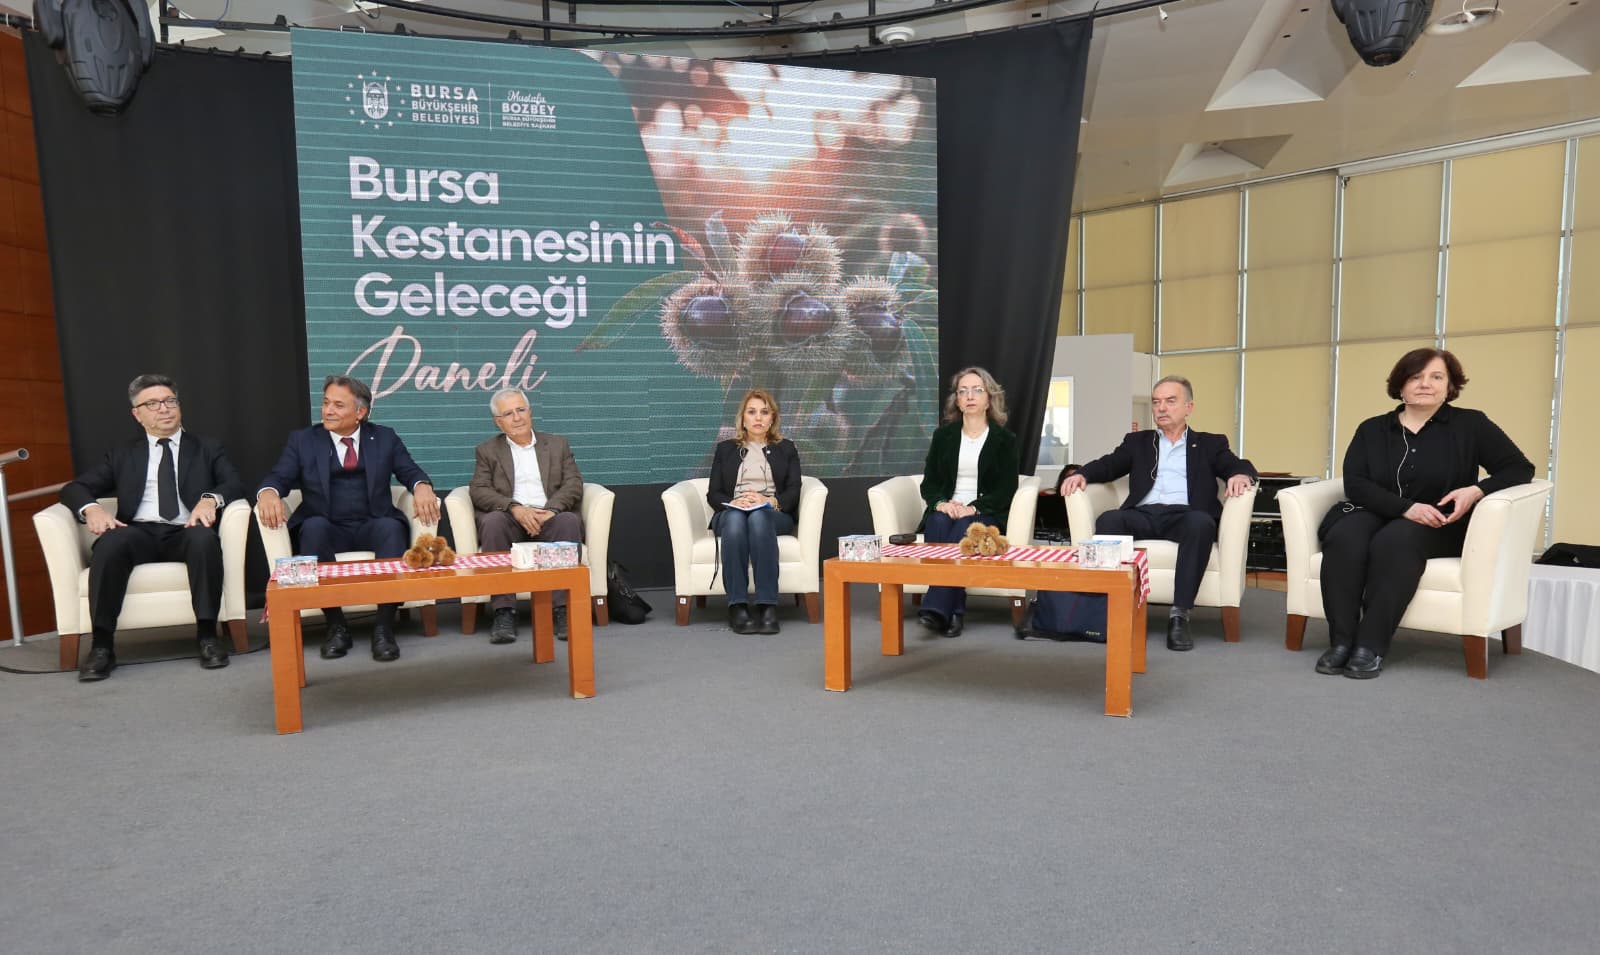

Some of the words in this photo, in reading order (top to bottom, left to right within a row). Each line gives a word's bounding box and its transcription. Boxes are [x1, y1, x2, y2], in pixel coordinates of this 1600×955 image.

[411, 84, 479, 101] BURSA
[411, 99, 479, 113] BÜYÜKŞEHİR
[502, 102, 556, 115] BOZBEY
[412, 111, 480, 125] BELEDİYESİ
[349, 156, 499, 204] Bursa
[352, 214, 675, 264] Kestanesinin
[354, 272, 587, 329] Geleceği
